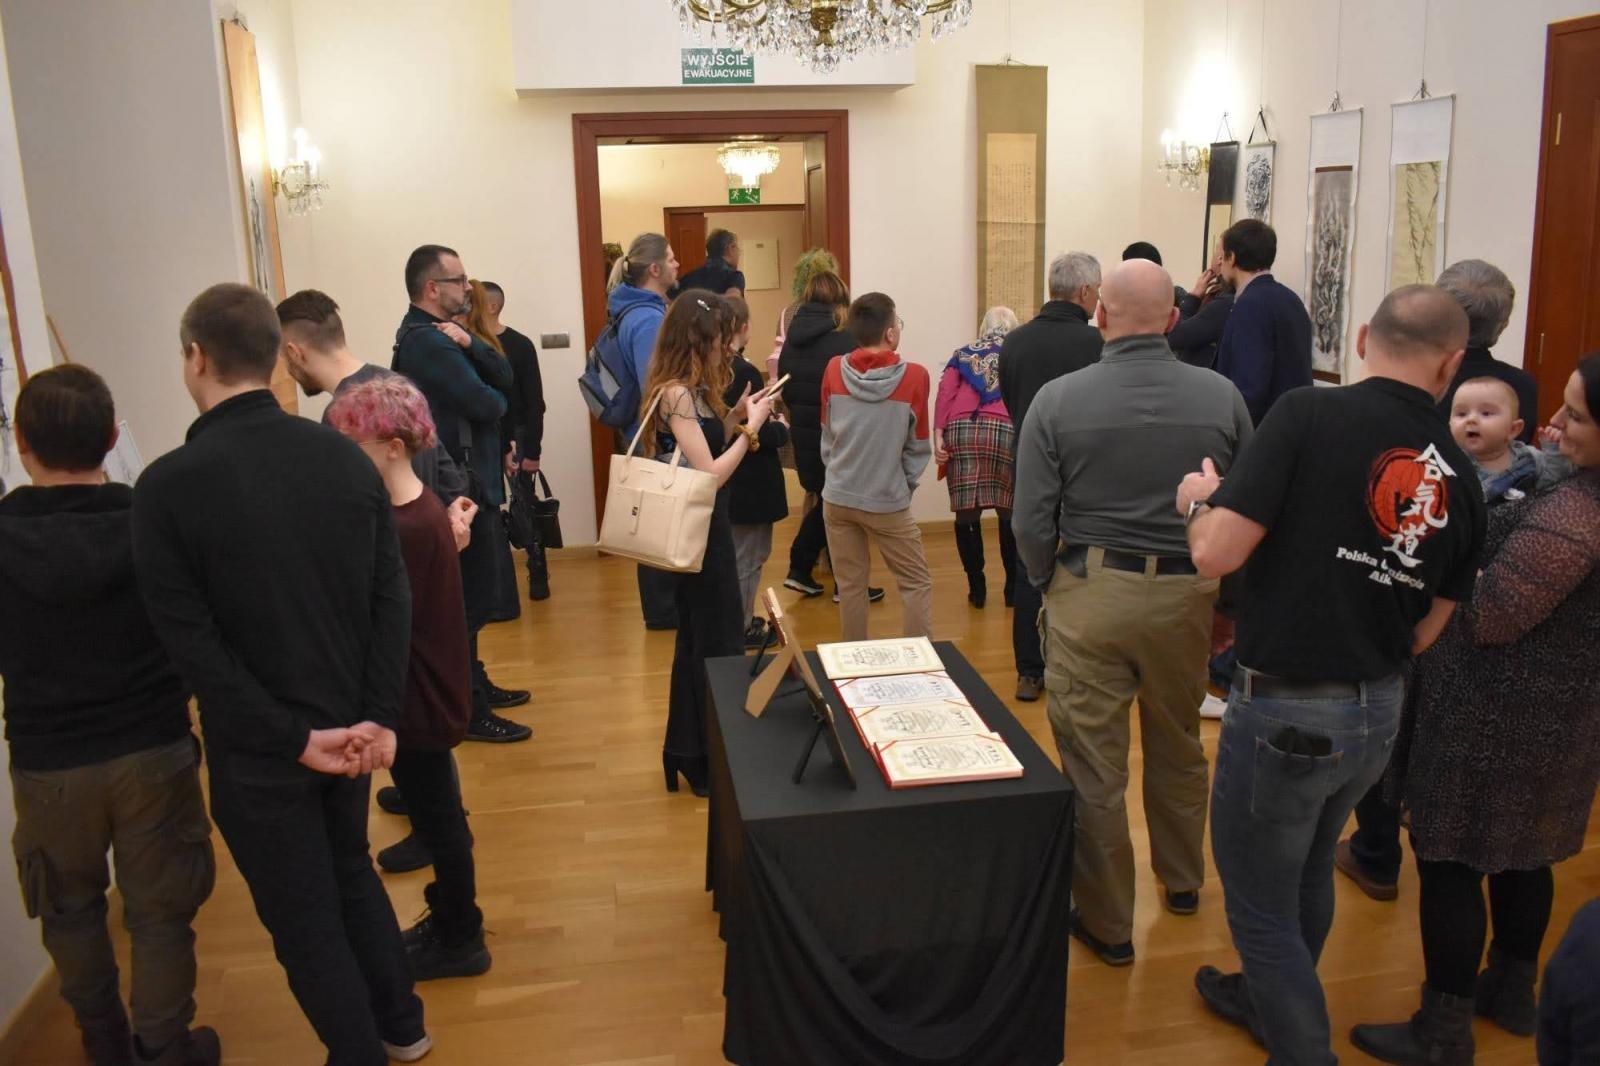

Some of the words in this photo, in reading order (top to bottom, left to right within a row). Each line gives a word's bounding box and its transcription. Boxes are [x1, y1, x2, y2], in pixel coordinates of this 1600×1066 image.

[687, 51, 749, 66] WYJŚCIE
[684, 69, 752, 78] EWAKUACYJNE
[1336, 546, 1378, 567] Polska
